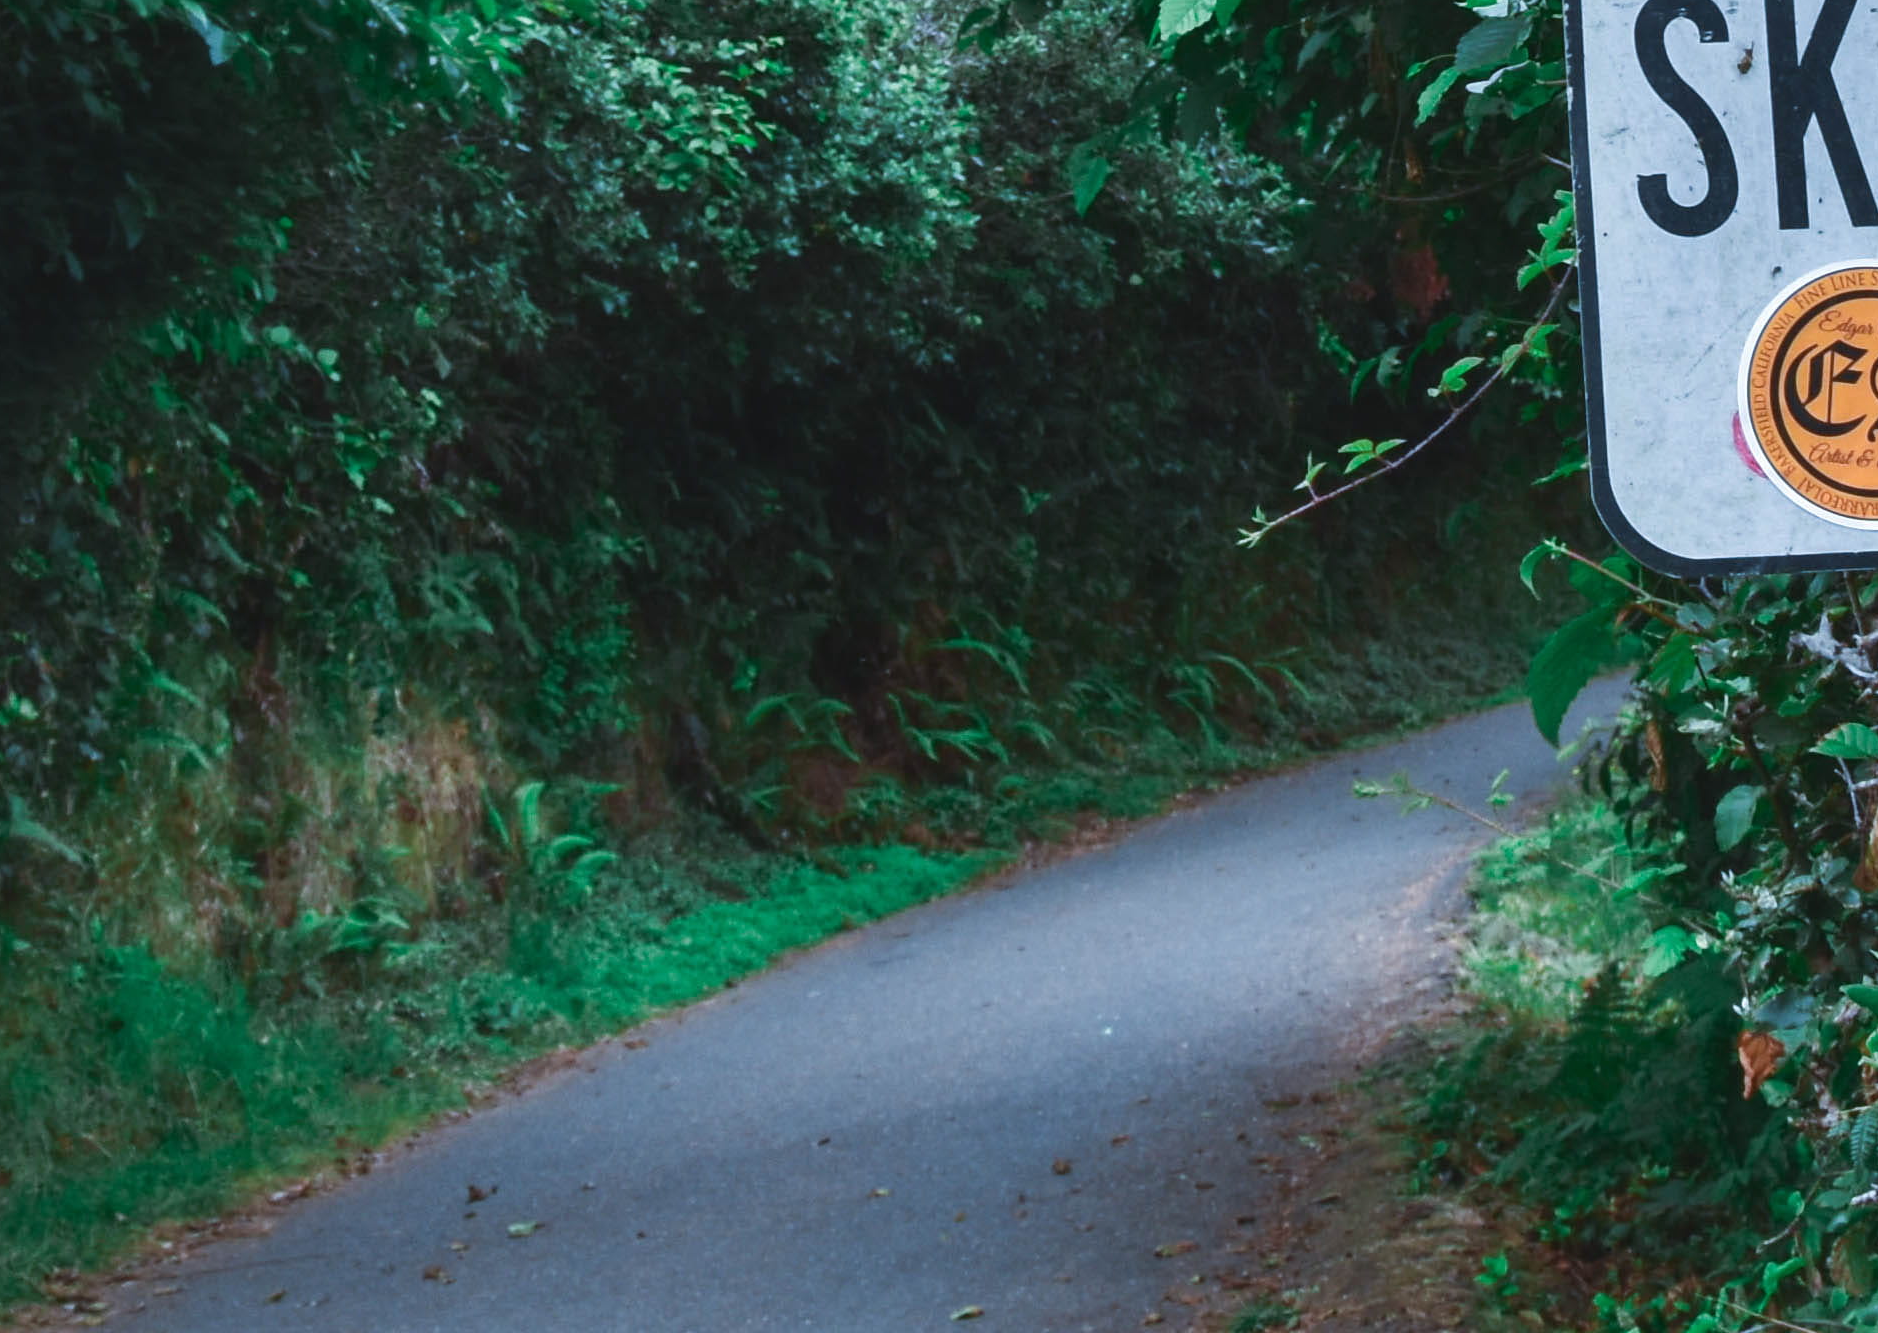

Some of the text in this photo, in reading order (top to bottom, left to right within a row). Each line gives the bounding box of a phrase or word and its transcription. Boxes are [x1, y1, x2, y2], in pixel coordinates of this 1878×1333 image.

[1818, 310, 1874, 341] Edgar
[1808, 442, 1852, 465] Artist
[1856, 449, 1875, 468] &
